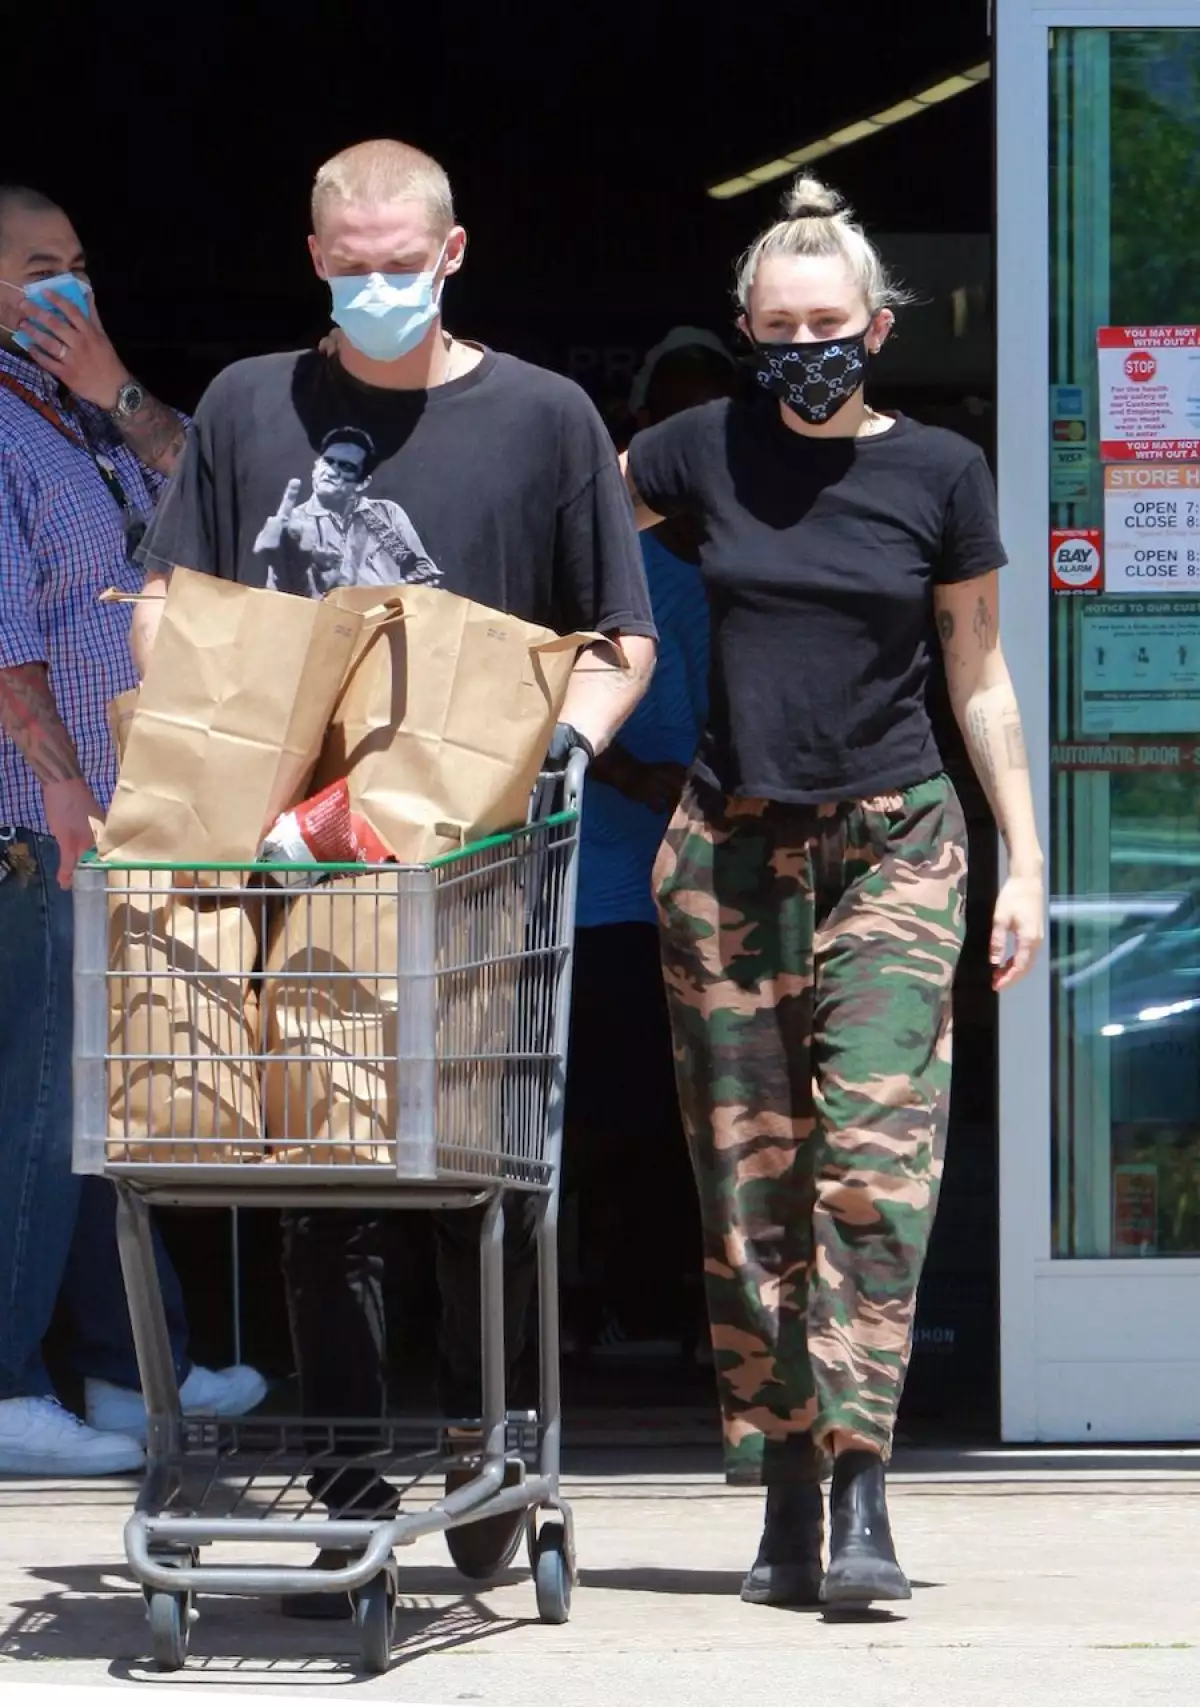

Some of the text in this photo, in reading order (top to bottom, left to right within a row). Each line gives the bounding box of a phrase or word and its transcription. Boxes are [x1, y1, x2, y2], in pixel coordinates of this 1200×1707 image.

[1124, 327, 1197, 338] YOU MAY NOT
[1133, 338, 1196, 348] WITH OUT A
[1126, 360, 1155, 374] STOP
[1131, 393, 1155, 401] safety
[1126, 400, 1169, 408] Customers
[1126, 441, 1199, 450] YOU MAY NOT
[1135, 450, 1198, 460] WITH OUT A
[1110, 468, 1179, 487] STORE
[1133, 502, 1177, 514] OPEN
[1124, 515, 1178, 528] CLOSE
[1058, 548, 1092, 563] BAY
[1134, 550, 1178, 562] OPEN
[1057, 564, 1092, 573] ALARM
[1125, 565, 1178, 577] CLOSE
[1085, 603, 1126, 613] NOTICE
[1128, 603, 1144, 613] TO
[1146, 603, 1171, 613] OUR
[1052, 745, 1136, 765] AUTOMATIC
[1138, 745, 1180, 766] DOOR
